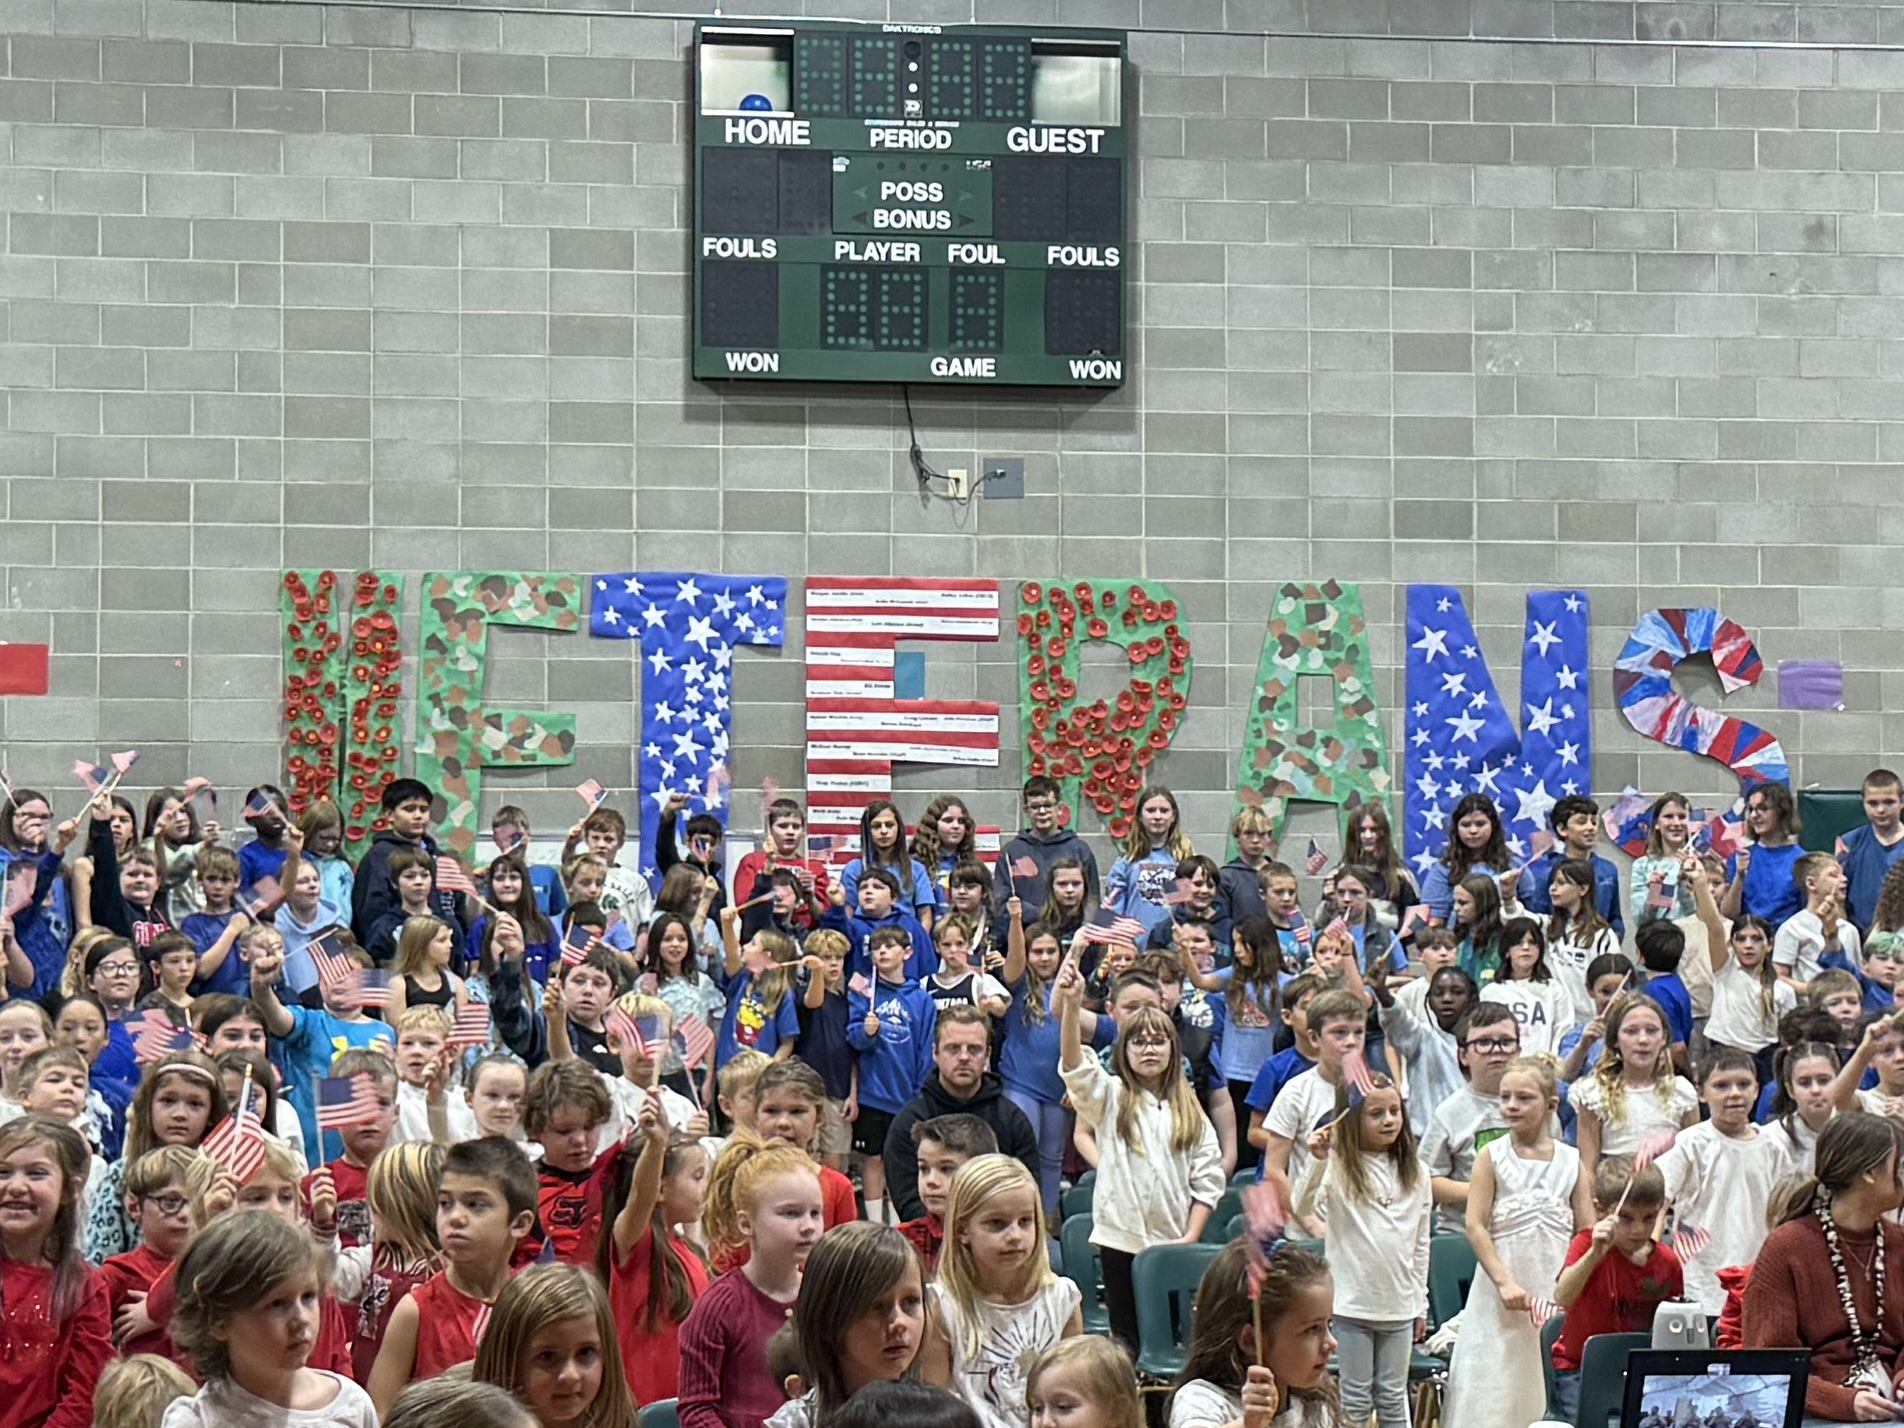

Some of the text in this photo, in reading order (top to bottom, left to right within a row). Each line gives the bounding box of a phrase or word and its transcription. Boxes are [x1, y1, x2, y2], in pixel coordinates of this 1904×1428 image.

[725, 119, 811, 146] HOME
[869, 128, 953, 150] PERIOD
[1006, 127, 1105, 154] GUEST
[881, 181, 944, 202] POSS
[873, 209, 952, 230] BONUS
[703, 238, 778, 259] FOULS
[834, 241, 921, 263] PLAYER
[948, 244, 1006, 265] FOUL
[1047, 246, 1120, 267] FOULS
[725, 352, 780, 373] WON
[930, 357, 997, 378] GAME
[1069, 359, 1122, 381] WON
[279, 570, 1793, 875] VETERANS
[1513, 1000, 1547, 1026] SA
